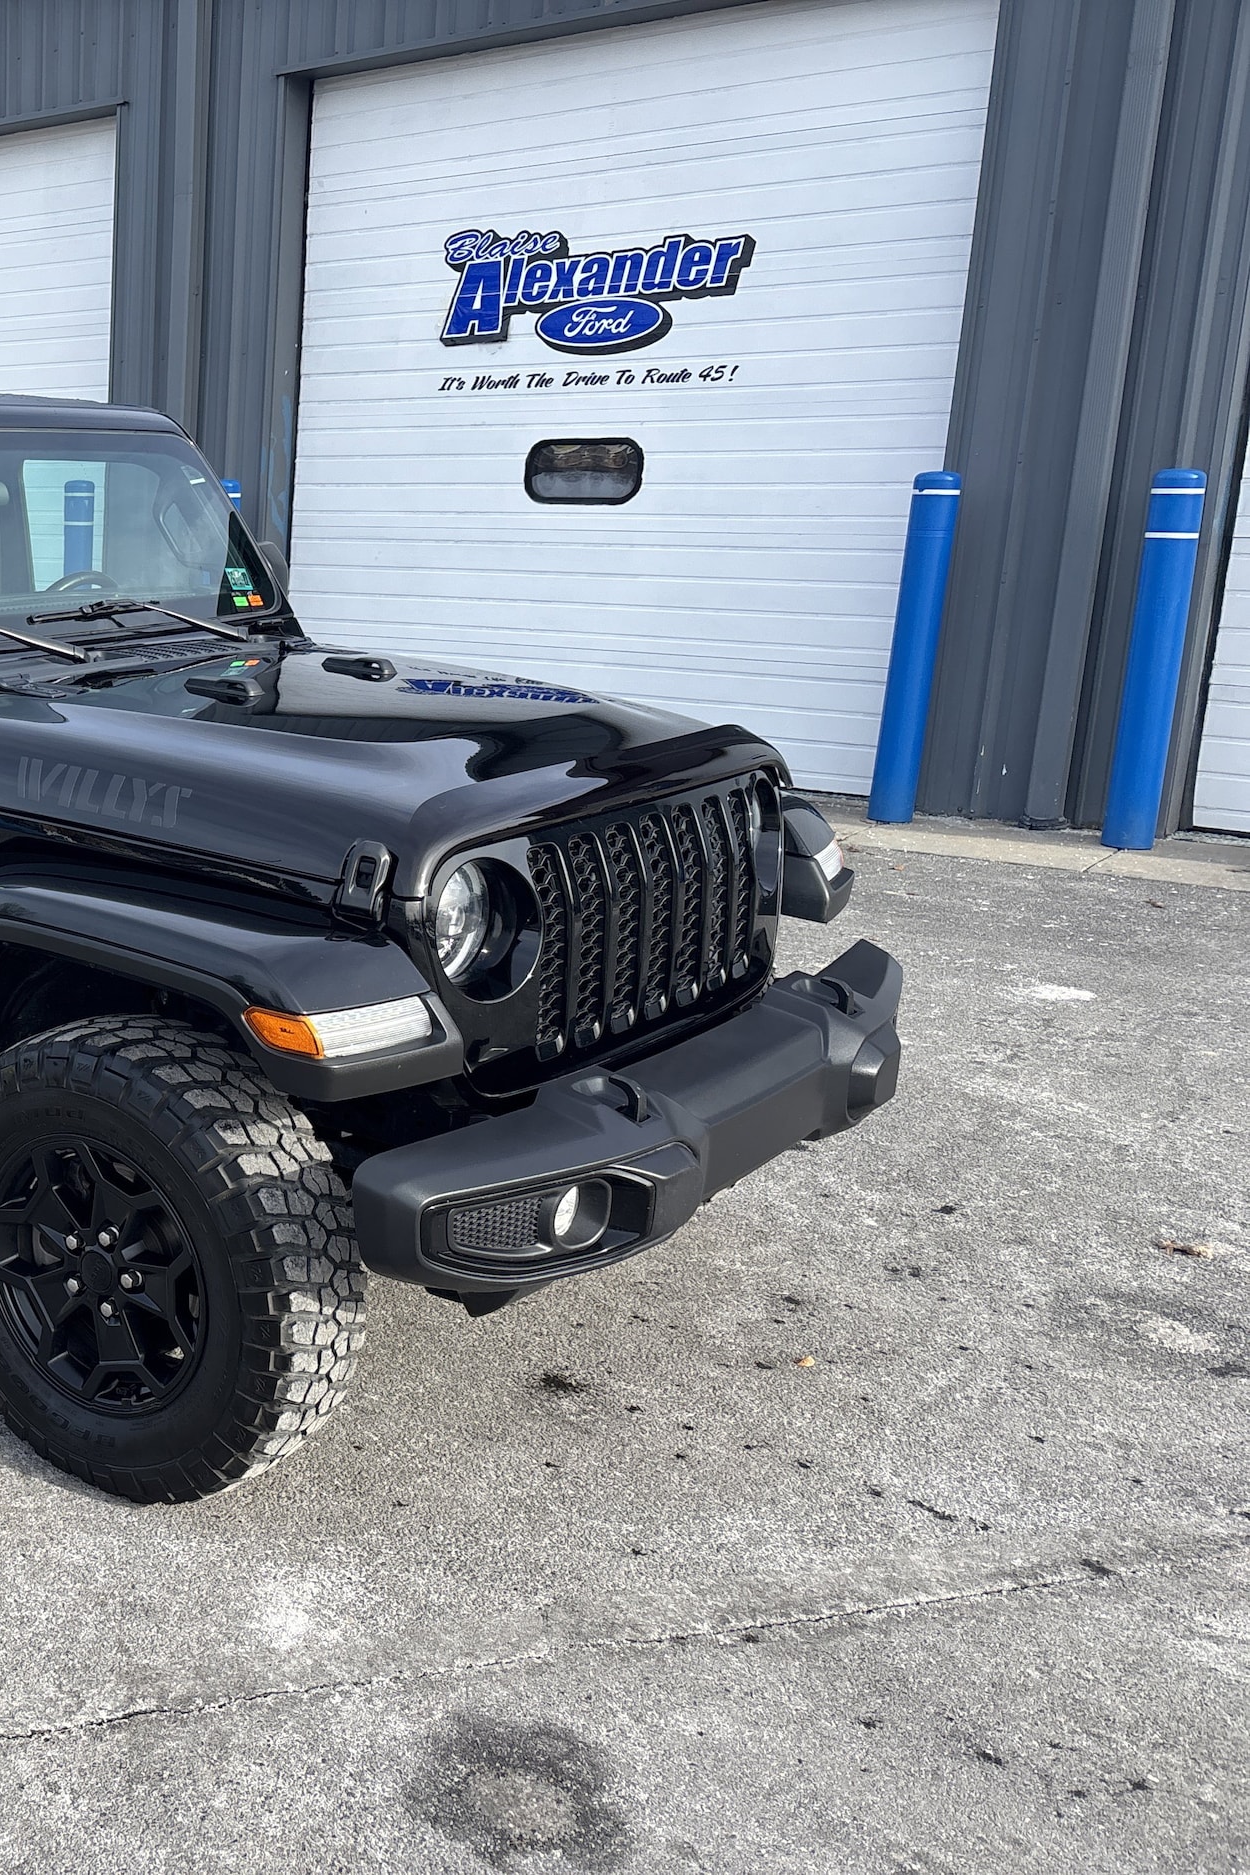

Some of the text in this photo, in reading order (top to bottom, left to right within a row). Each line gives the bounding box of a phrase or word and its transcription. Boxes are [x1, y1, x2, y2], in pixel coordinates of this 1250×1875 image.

[444, 229, 568, 264] Blaise
[440, 236, 754, 344] Alexander
[564, 305, 635, 338] Ford
[437, 376, 467, 392] It's
[470, 373, 520, 391] Worth
[525, 372, 555, 389] The
[561, 371, 610, 388] Drive
[615, 369, 636, 385] To
[641, 367, 693, 385] Route
[17, 755, 193, 829] WILLYS
